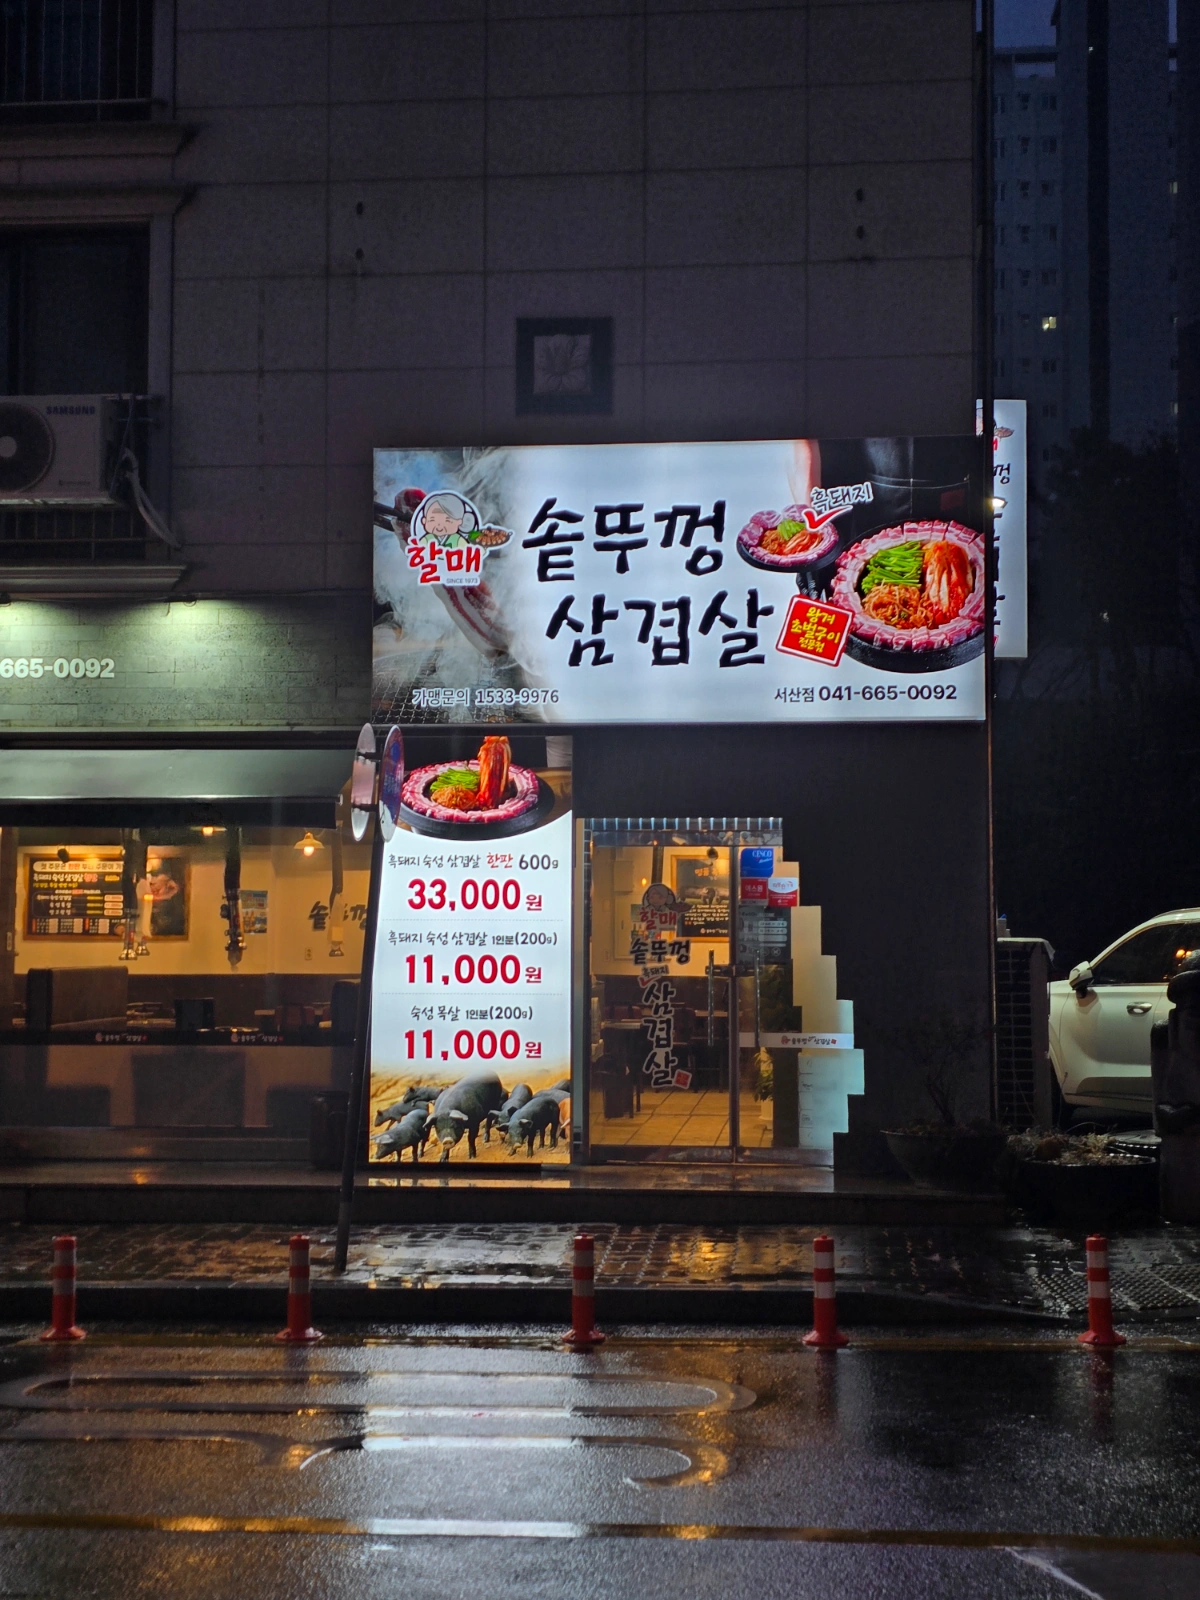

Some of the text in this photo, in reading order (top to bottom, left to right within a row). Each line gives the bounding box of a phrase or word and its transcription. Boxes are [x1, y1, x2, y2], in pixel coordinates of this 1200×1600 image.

[46, 405, 96, 415] SAMSUNG
[812, 482, 873, 512] 흑돼지
[522, 496, 727, 584] 솥뚜껑
[407, 537, 481, 584] 할매
[545, 588, 774, 668] 삼겹살
[806, 606, 836, 626] 왕겨
[791, 618, 841, 644] 초벌구이
[798, 636, 826, 653] 전문점
[0, 658, 115, 678] 665-0092
[411, 687, 560, 707] 가맹문의 1533-9976
[772, 684, 958, 703] 서산점 041-665-0092
[387, 851, 559, 871] 흑돼지 숙성 삼겹살 한판 600g
[407, 878, 543, 912] 33,000원
[639, 906, 677, 931] 할매
[387, 930, 558, 948] 흑돼지 숙성 삼겹살 1인분(200g)
[630, 938, 691, 965] 솥뚜껑
[405, 954, 543, 986] 11,000원
[410, 1005, 533, 1022] 숙성 목살 1인분(200g)
[404, 1029, 543, 1061] 11,000원
[643, 982, 677, 1087] 삼겹살
